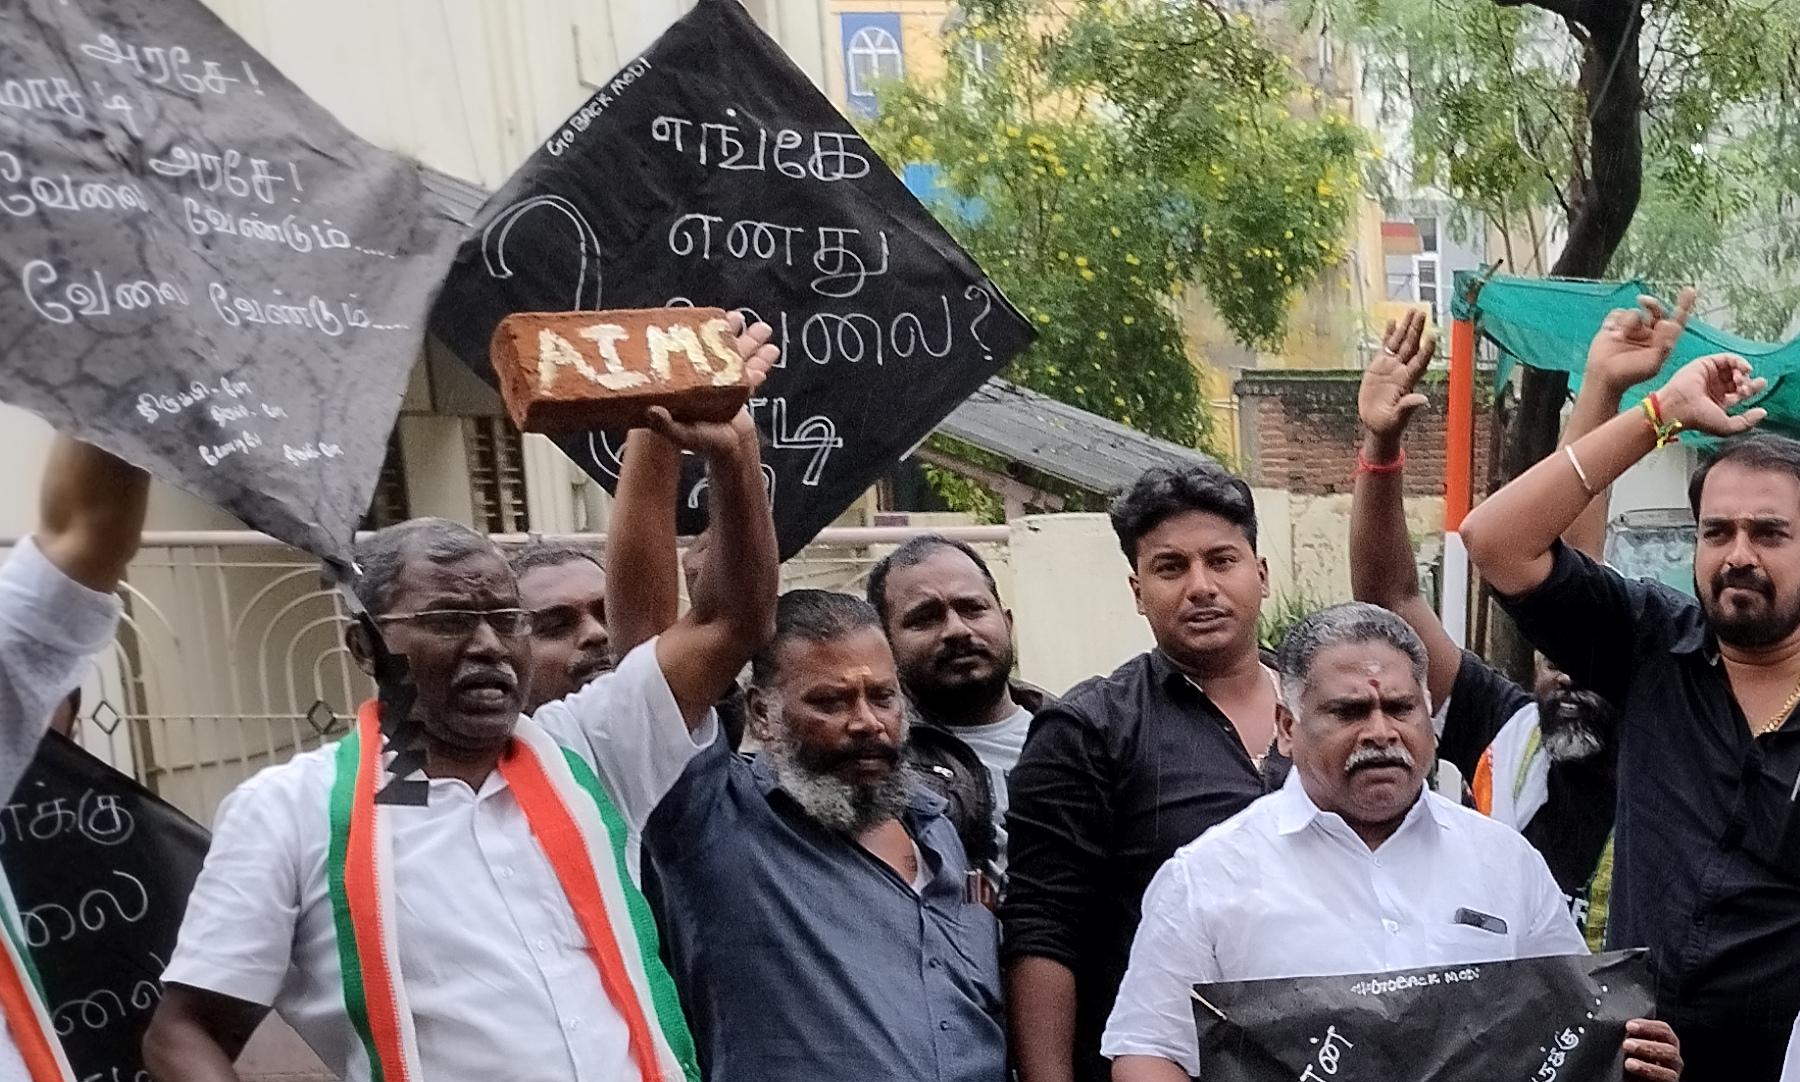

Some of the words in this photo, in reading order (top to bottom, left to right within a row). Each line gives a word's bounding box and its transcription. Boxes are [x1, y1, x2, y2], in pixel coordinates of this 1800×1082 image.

[652, 108, 870, 181] எங்கே
[669, 213, 890, 298] எனது
[537, 319, 744, 397] AIMS
